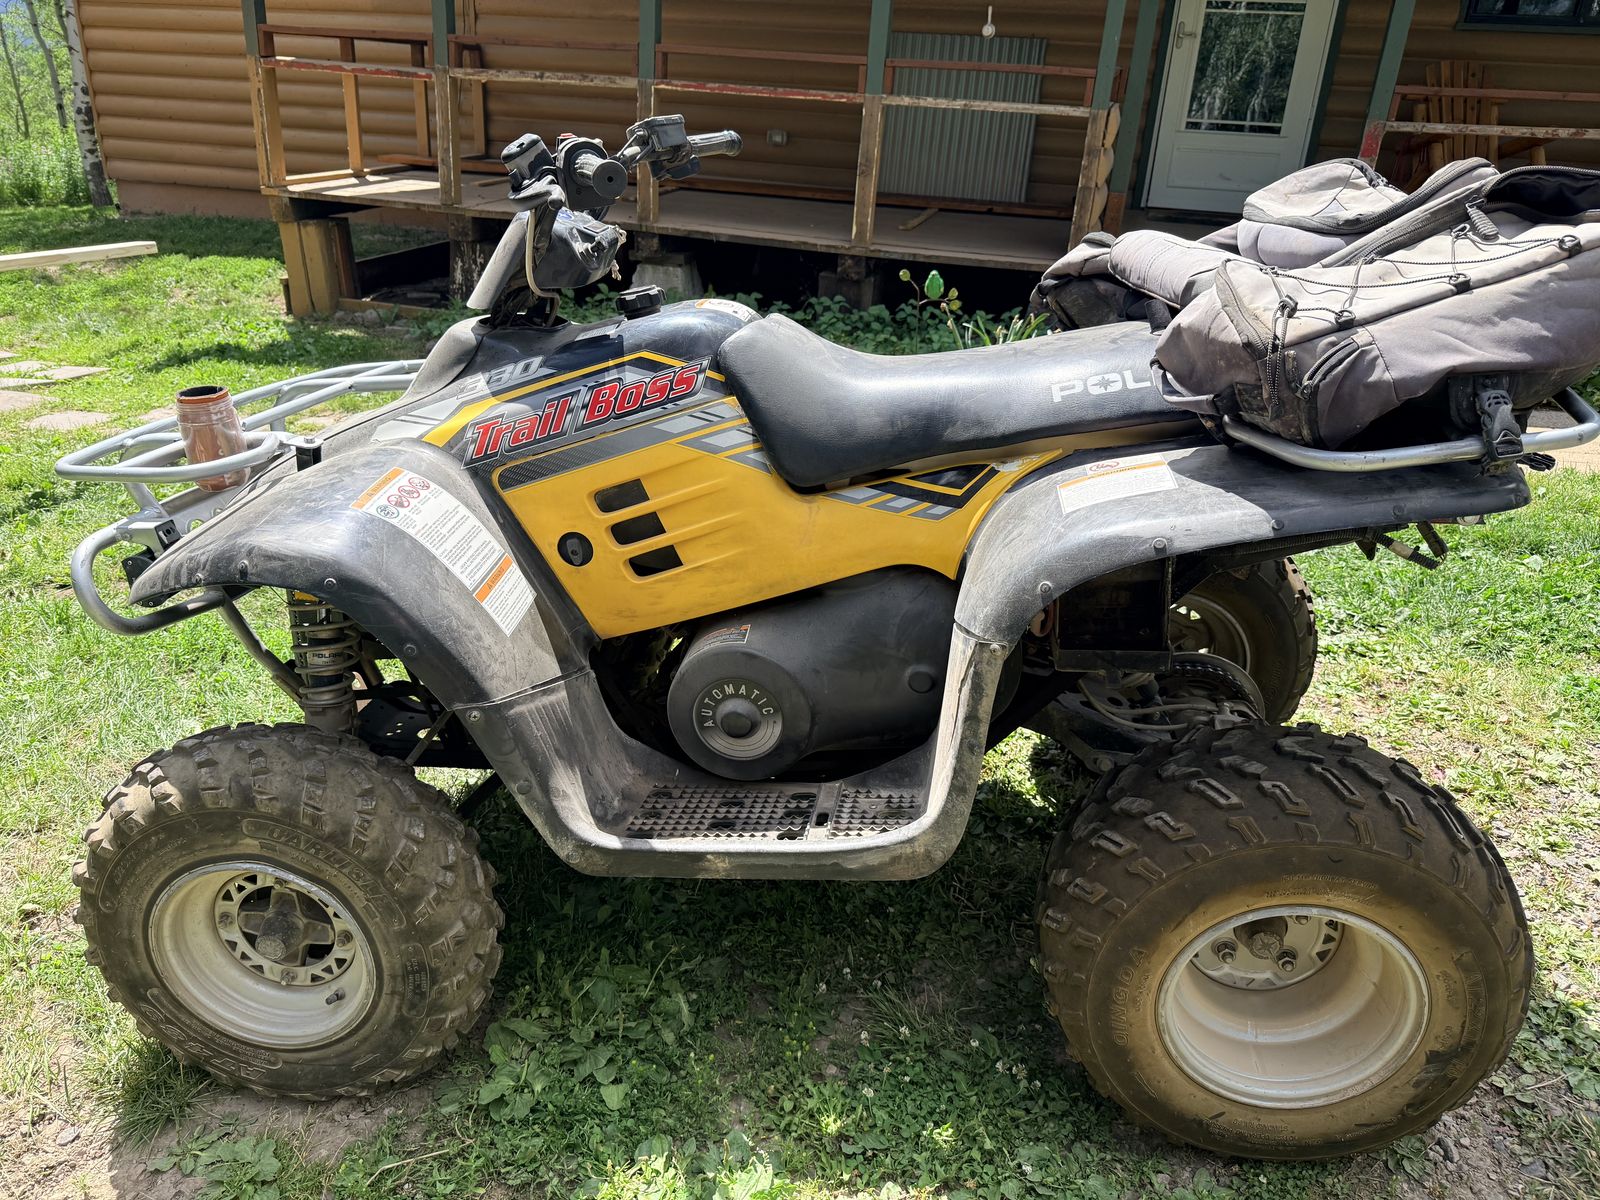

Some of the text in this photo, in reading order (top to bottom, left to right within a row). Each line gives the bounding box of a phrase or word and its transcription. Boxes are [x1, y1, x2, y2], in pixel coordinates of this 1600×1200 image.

[473, 363, 702, 459] Trail Boss
[701, 683, 774, 728] AUTOMATIC
